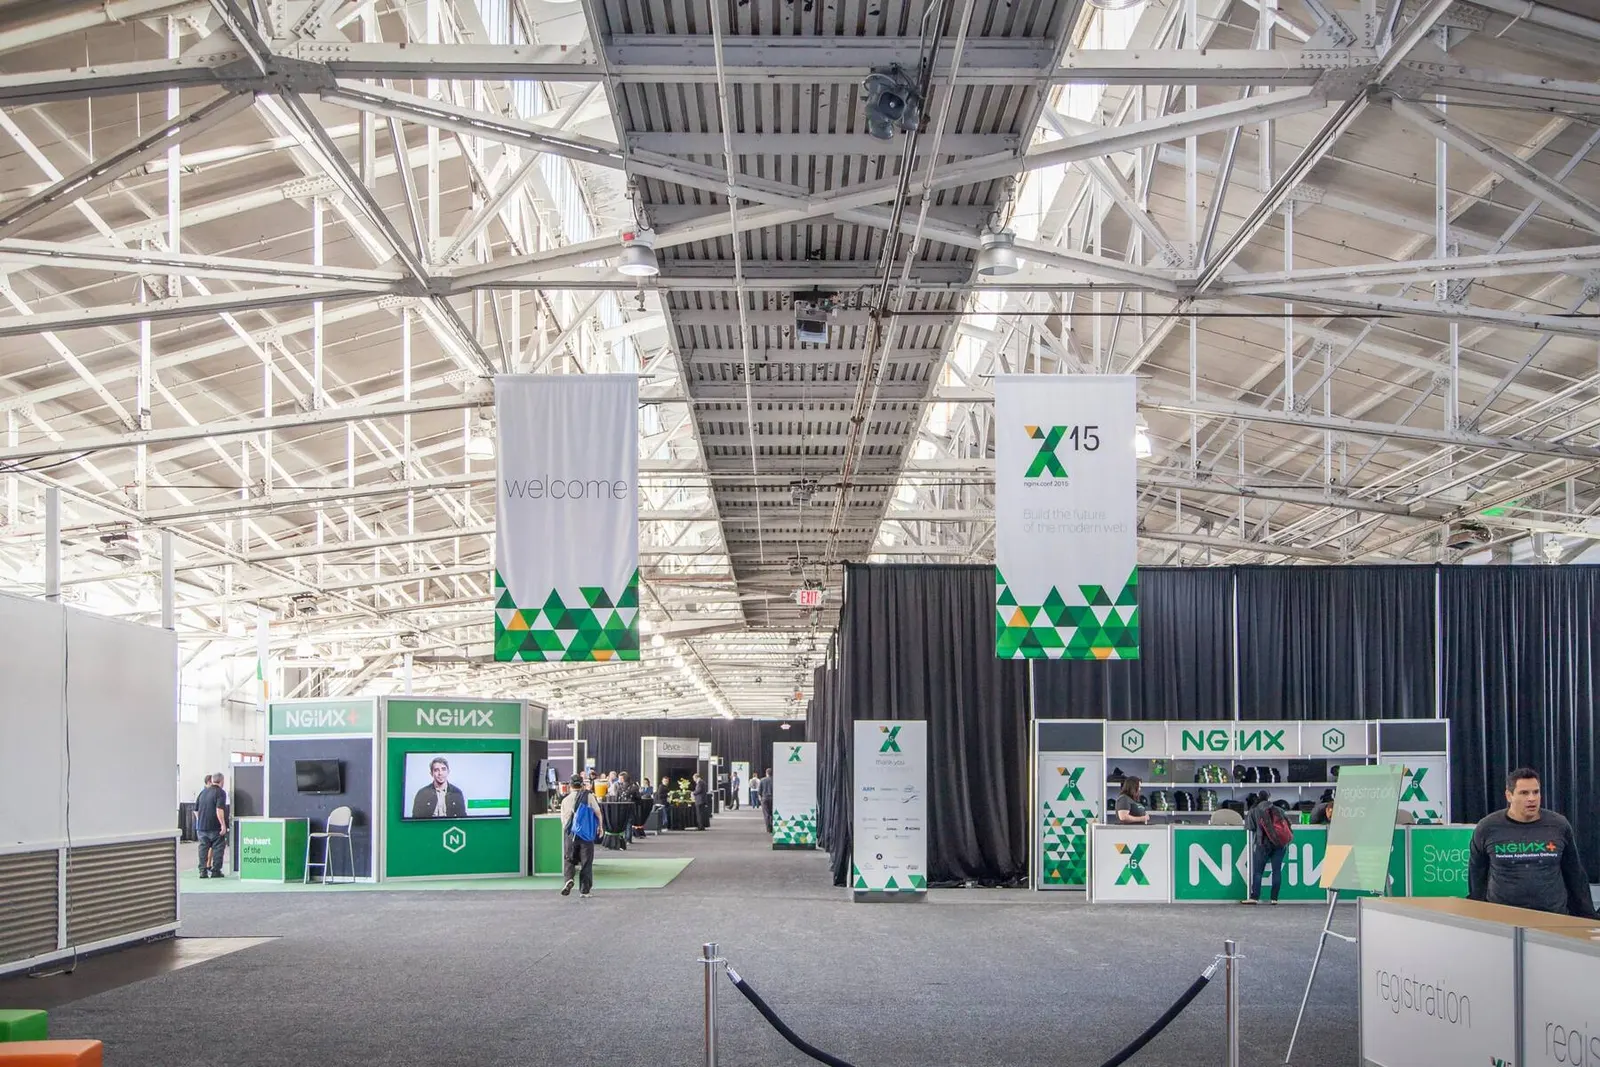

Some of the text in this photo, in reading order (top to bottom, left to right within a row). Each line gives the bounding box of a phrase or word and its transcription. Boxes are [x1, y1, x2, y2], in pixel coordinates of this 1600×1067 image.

[504, 474, 628, 500] welcome
[1023, 480, 1053, 488] nginx.conf
[1023, 508, 1107, 520] Build the future
[1023, 521, 1128, 534] of the modern web
[801, 591, 818, 604] EXIT
[1341, 784, 1399, 802] registration
[1338, 804, 1366, 818] hours
[243, 837, 272, 845] the heart
[243, 856, 281, 864] modern web
[1423, 844, 1470, 866] Swag
[1423, 864, 1469, 882] Store
[1376, 966, 1472, 1029] registration
